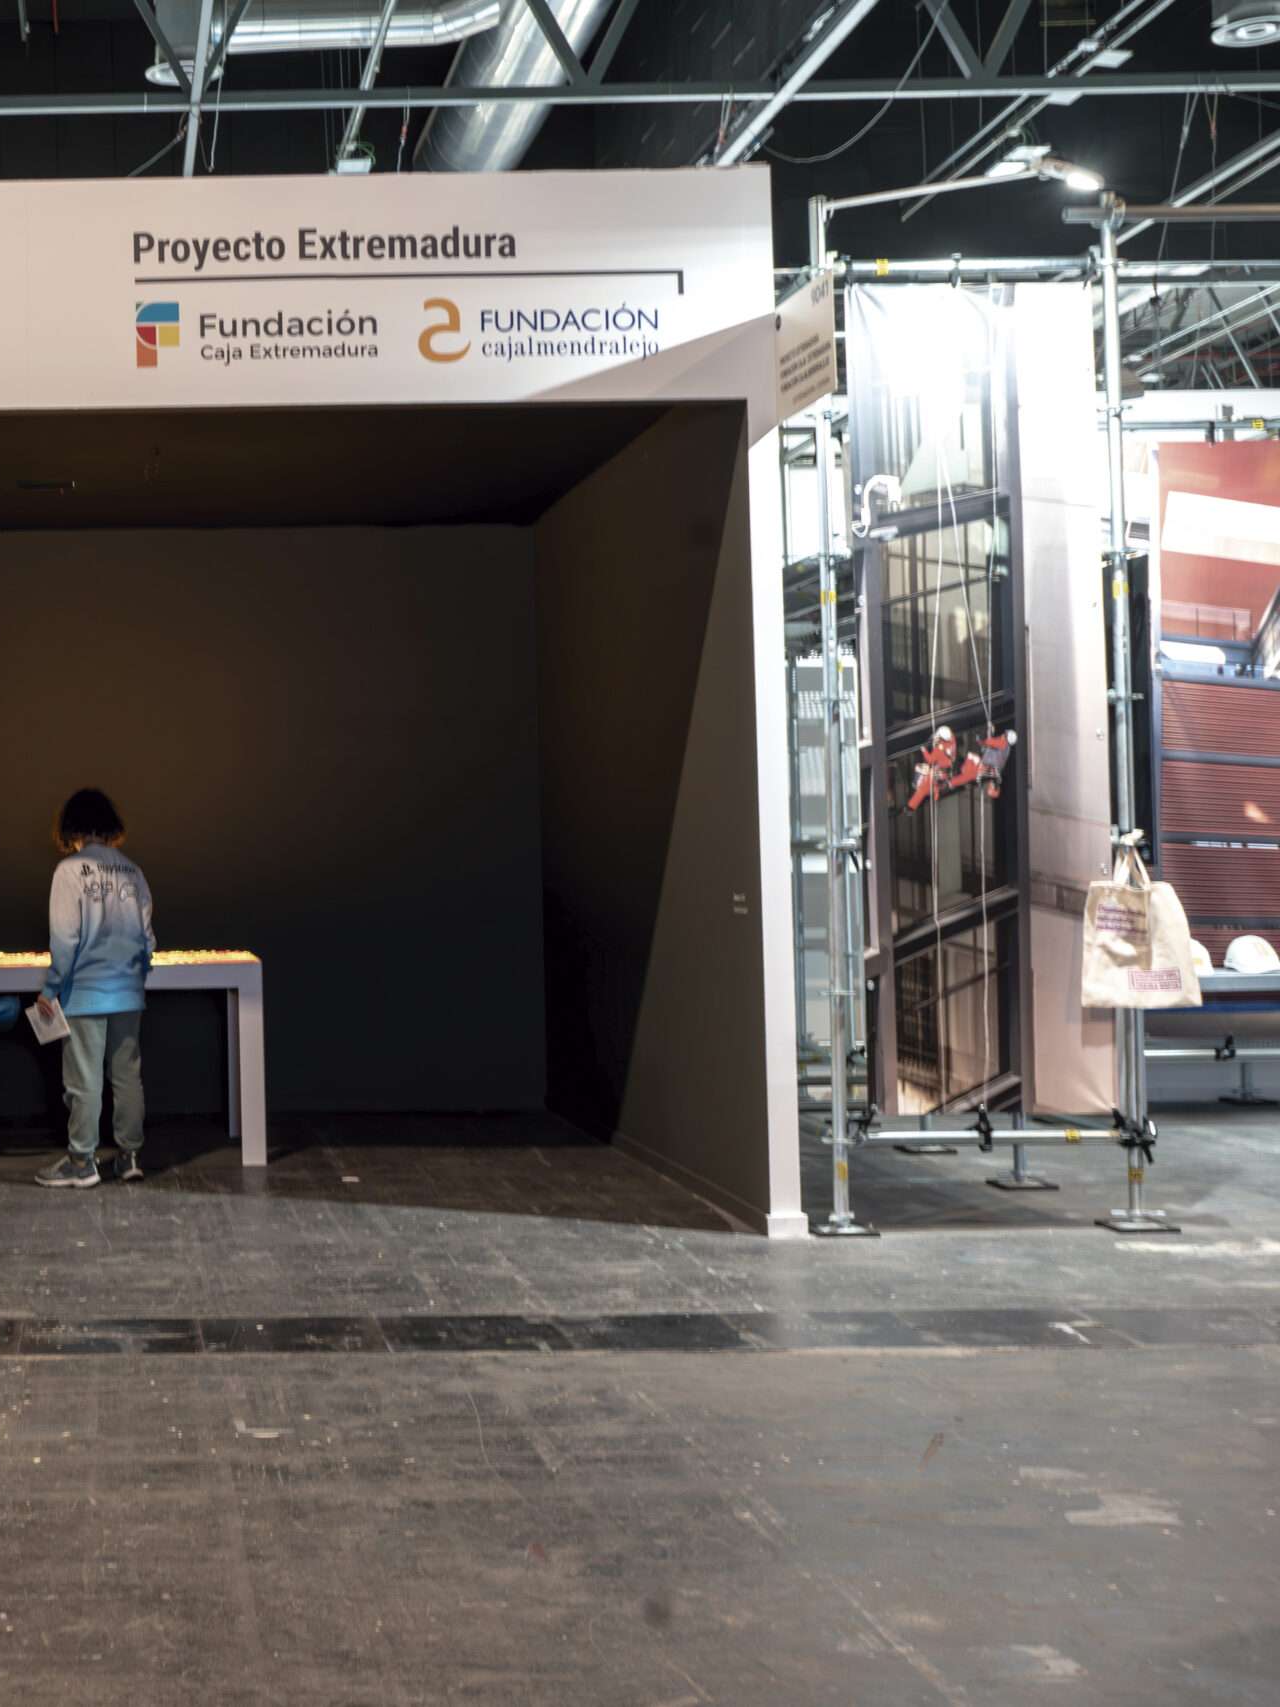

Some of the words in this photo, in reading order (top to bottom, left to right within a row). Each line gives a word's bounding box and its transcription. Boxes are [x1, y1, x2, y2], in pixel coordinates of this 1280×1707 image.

[132, 231, 286, 271] Proyecto
[298, 226, 517, 261] Extremadura
[199, 309, 379, 338] Fundación
[480, 301, 659, 333] FUNDACIÓN
[200, 344, 243, 366] Caja
[250, 341, 379, 360] Extremadura
[481, 334, 660, 363] cajalmendralejo
